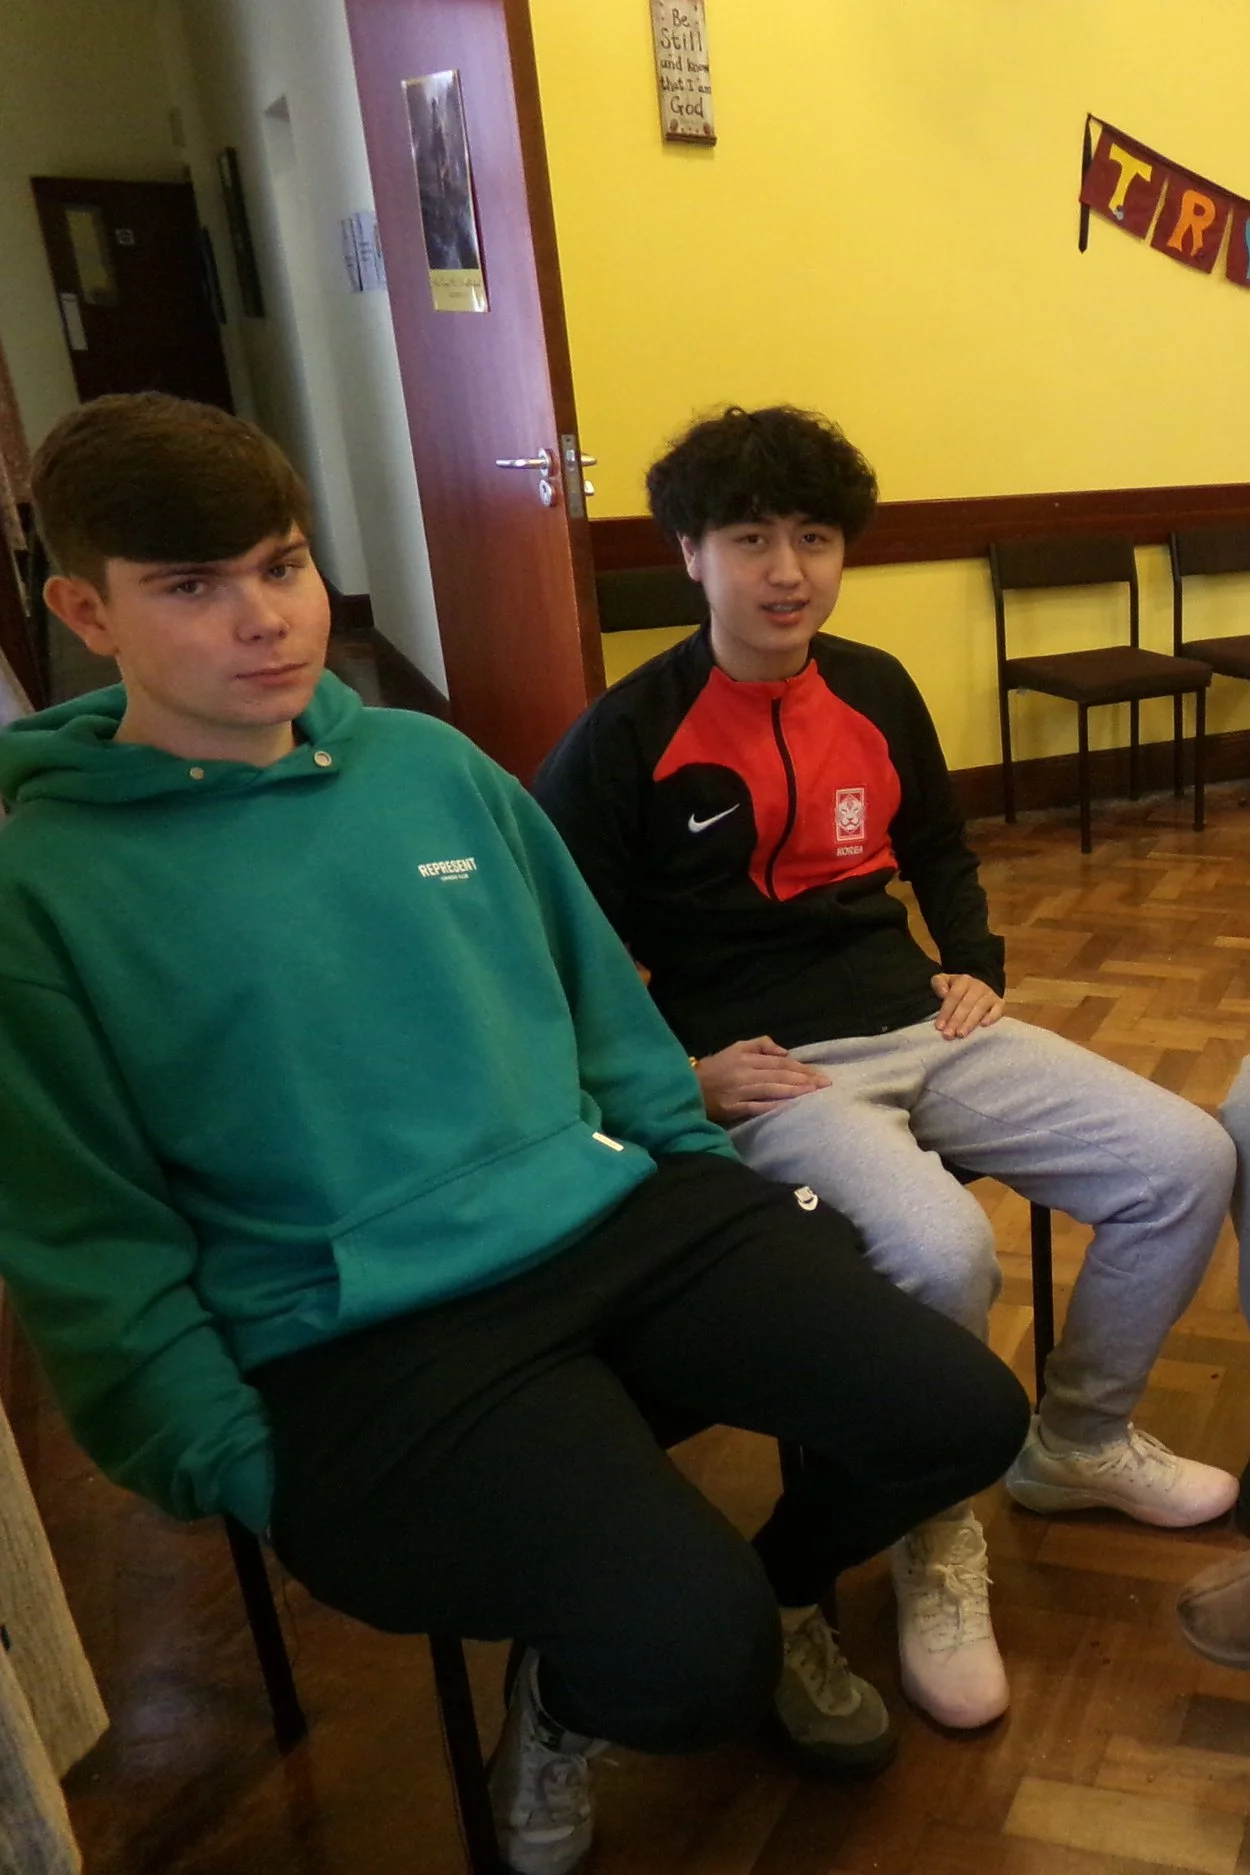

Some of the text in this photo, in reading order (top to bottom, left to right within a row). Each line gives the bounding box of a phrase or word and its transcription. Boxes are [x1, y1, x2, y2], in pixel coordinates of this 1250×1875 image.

[672, 8, 690, 27] Be
[660, 28, 702, 52] Still
[660, 56, 682, 71] and
[660, 76, 684, 91] that
[687, 79, 694, 92] I
[670, 95, 704, 118] God
[837, 846, 863, 856] KOREA
[418, 857, 477, 877] REPRESENT
